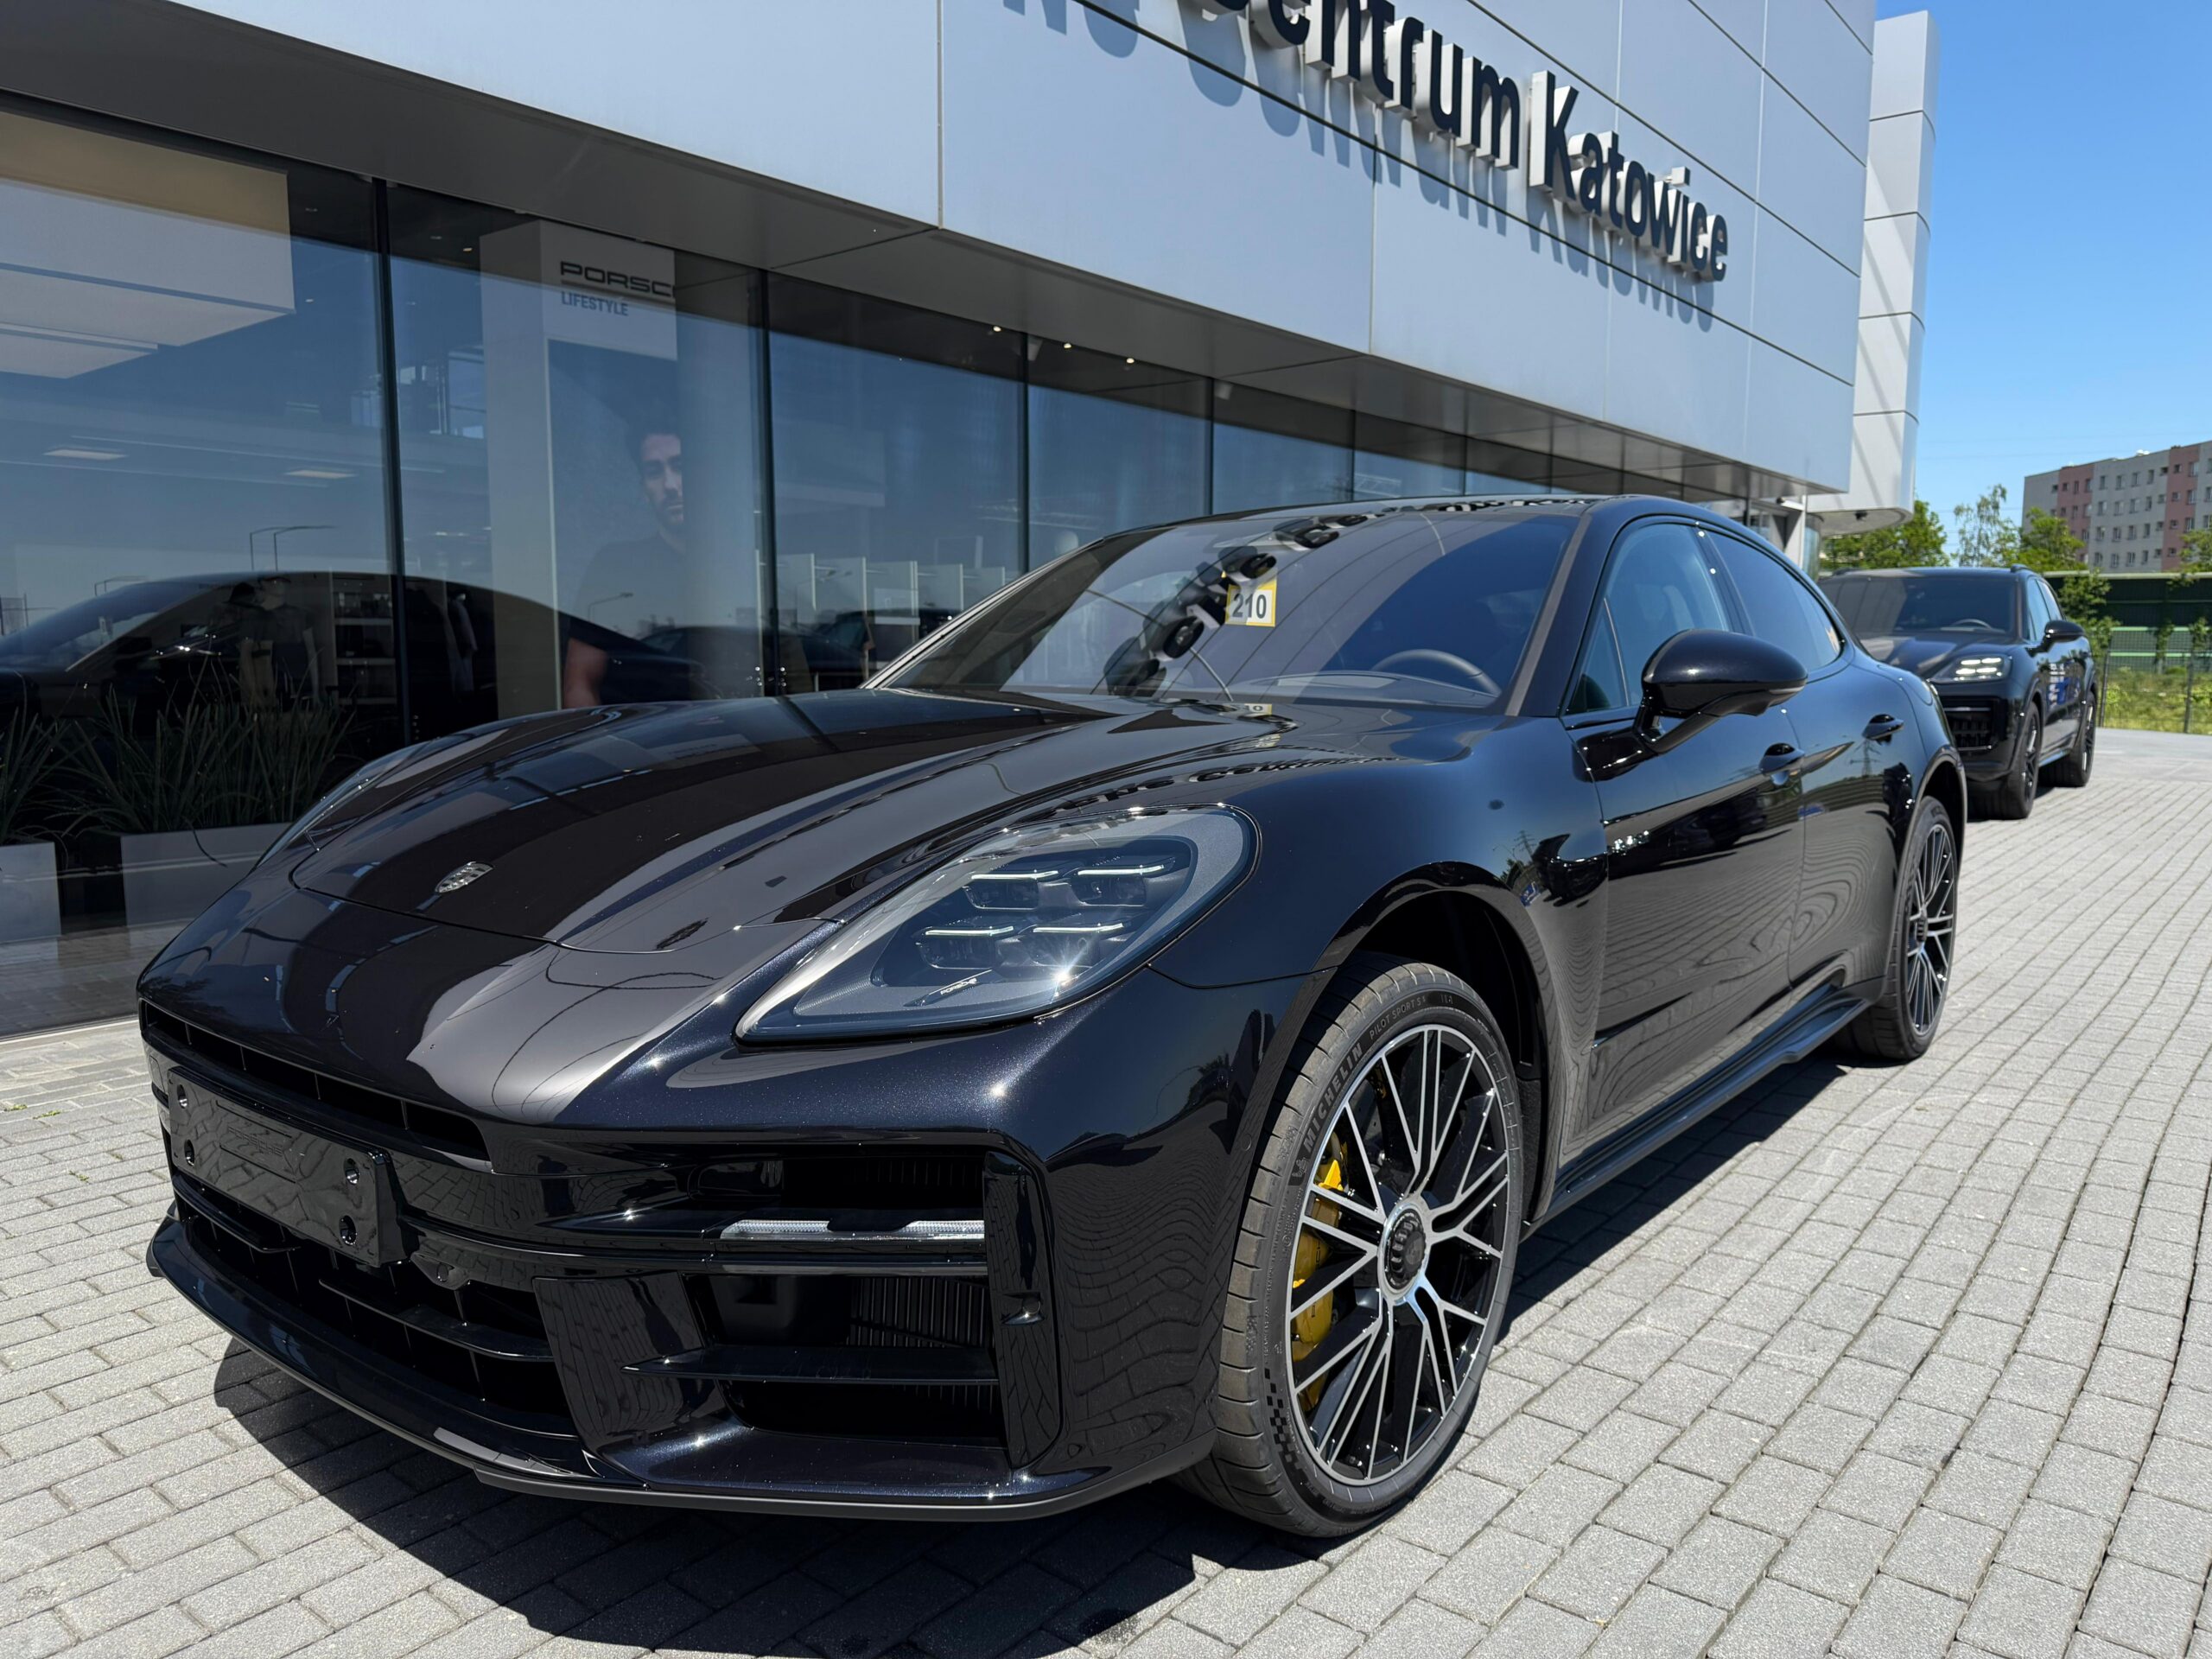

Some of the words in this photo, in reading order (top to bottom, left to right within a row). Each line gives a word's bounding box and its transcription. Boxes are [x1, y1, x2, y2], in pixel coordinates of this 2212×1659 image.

[1185, 0, 1520, 169] ntrum
[1529, 70, 1728, 283] Katowice
[562, 290, 629, 316] LIFESTYLE
[1231, 593, 1267, 620] 210
[1303, 1042, 1363, 1154] MICHELIN
[1369, 1014, 1390, 1039] PILOT
[1391, 1001, 1415, 1020] SPORT
